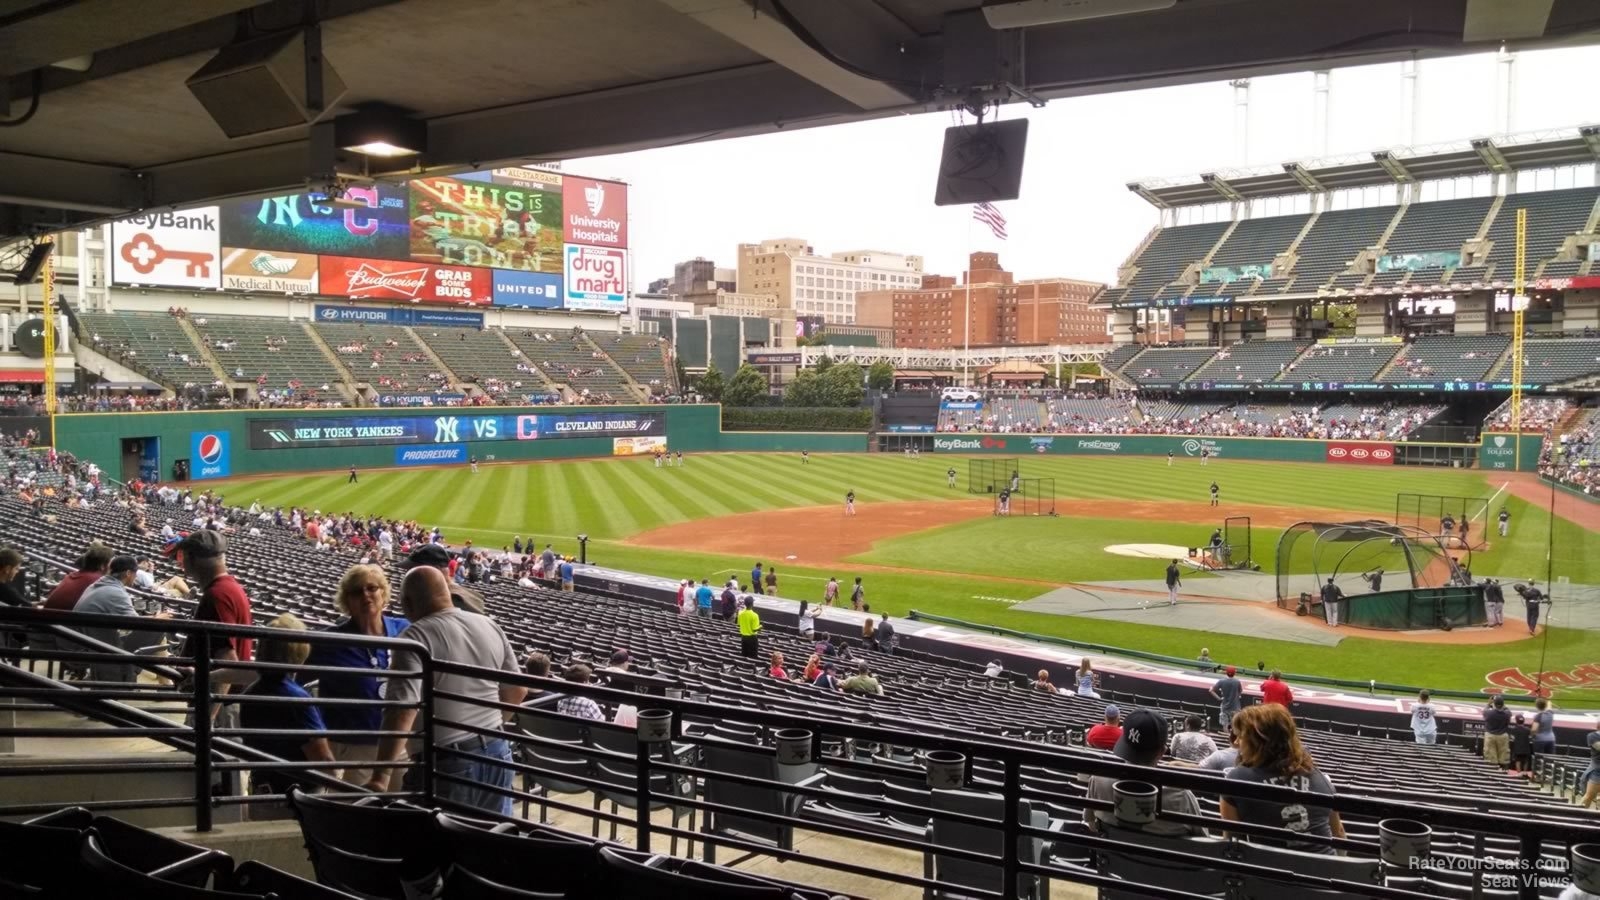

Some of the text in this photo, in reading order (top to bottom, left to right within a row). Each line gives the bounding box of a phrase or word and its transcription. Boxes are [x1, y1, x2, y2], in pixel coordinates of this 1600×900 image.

[540, 174, 559, 184] GAME
[435, 181, 542, 212] THIS IS
[570, 214, 620, 232] University
[572, 228, 618, 243] Hospitals
[572, 247, 615, 278] drug
[346, 270, 426, 288] Budweiser
[435, 269, 472, 281] GRAB
[229, 277, 312, 293] Medical Mutual
[441, 279, 466, 287] SOME
[577, 277, 625, 294] mart
[435, 285, 472, 298] BUDS
[497, 284, 543, 295] UNITED
[341, 310, 387, 320] HYUNDAI
[294, 425, 404, 439] NEW YORK YANKEES
[473, 418, 498, 438] VS
[516, 414, 538, 440] C
[555, 420, 637, 432] CLEVELAND INDIANS
[934, 438, 981, 450] KeyBank
[403, 448, 459, 460] PROGRESSIVE
[201, 465, 220, 476] pepsi
[1417, 710, 1430, 719] 33
